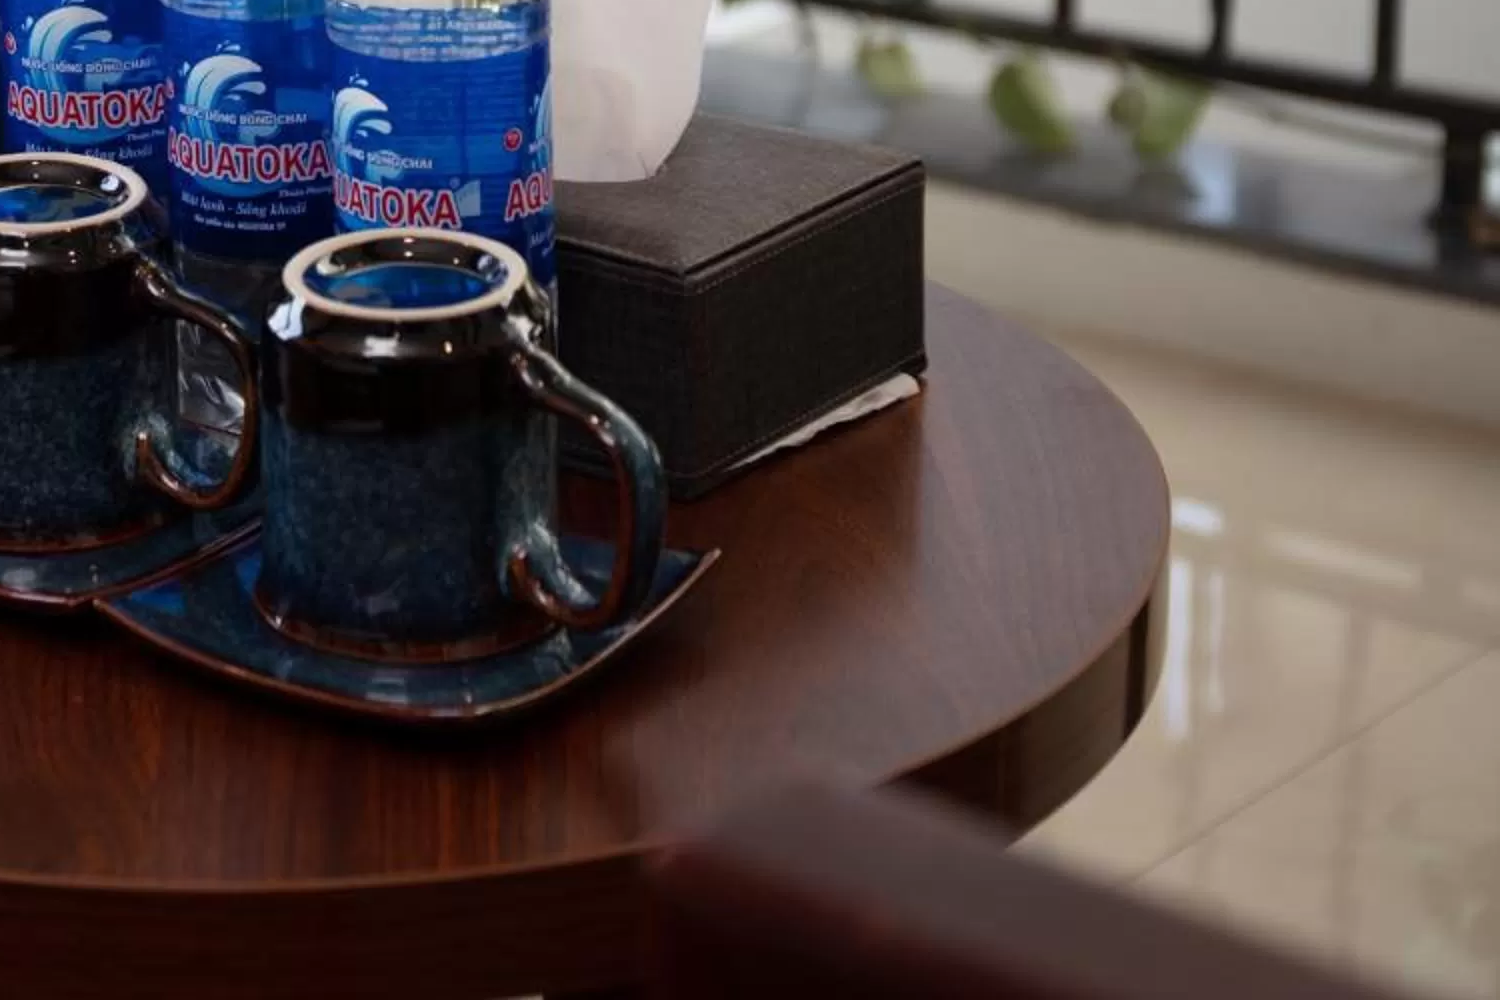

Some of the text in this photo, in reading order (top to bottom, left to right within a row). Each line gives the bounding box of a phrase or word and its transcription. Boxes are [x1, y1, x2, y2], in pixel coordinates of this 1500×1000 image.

[7, 80, 167, 130] AQUATOKA
[167, 125, 336, 184] AQUATOKA
[334, 168, 461, 229] UATOKA
